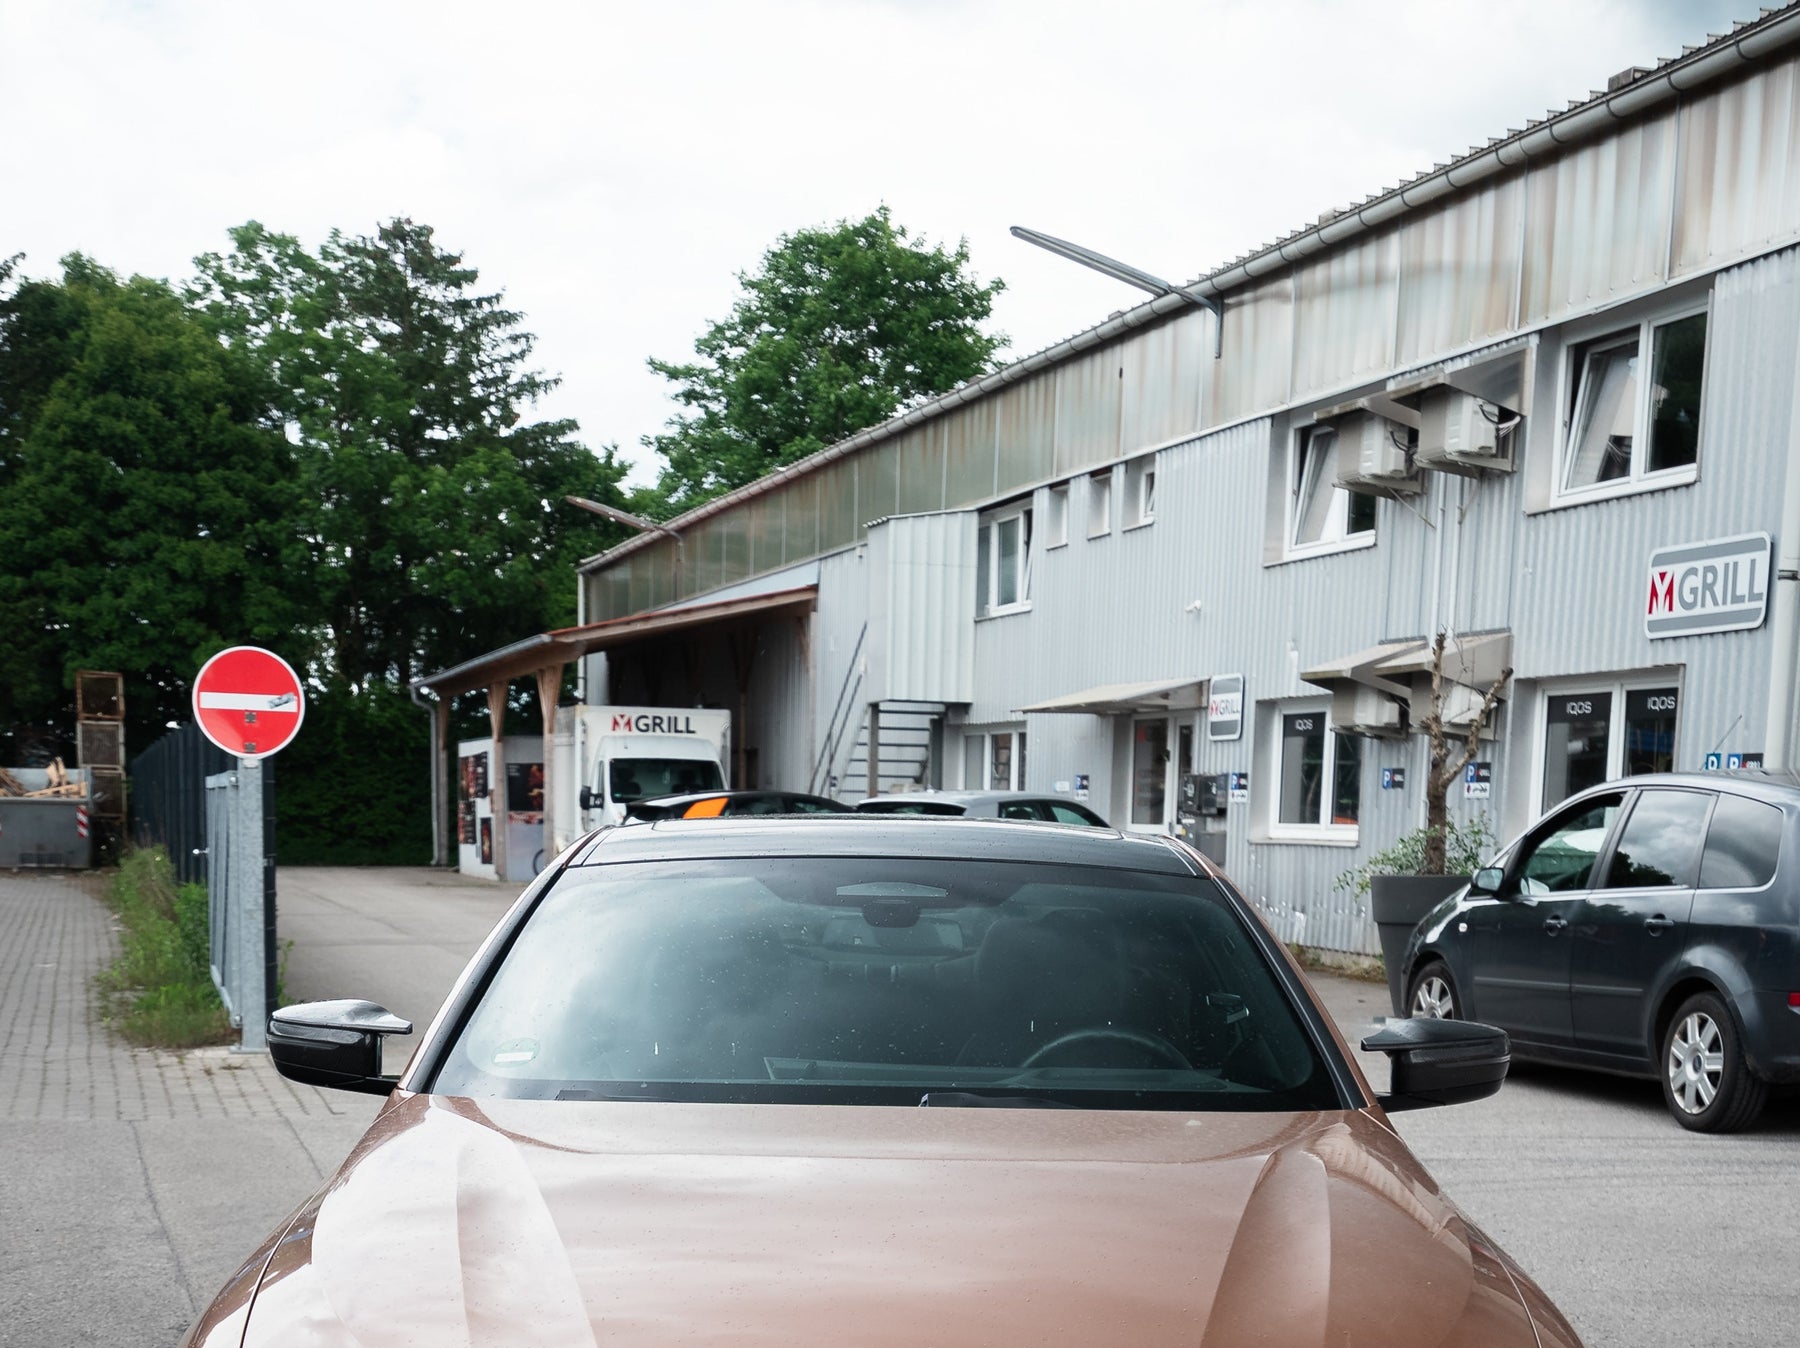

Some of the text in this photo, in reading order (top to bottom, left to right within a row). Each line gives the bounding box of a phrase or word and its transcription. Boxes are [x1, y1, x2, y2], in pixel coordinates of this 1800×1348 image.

[1566, 701, 1593, 716] IQOS
[1647, 696, 1676, 712] IQOS
[1294, 718, 1314, 731] IQOS
